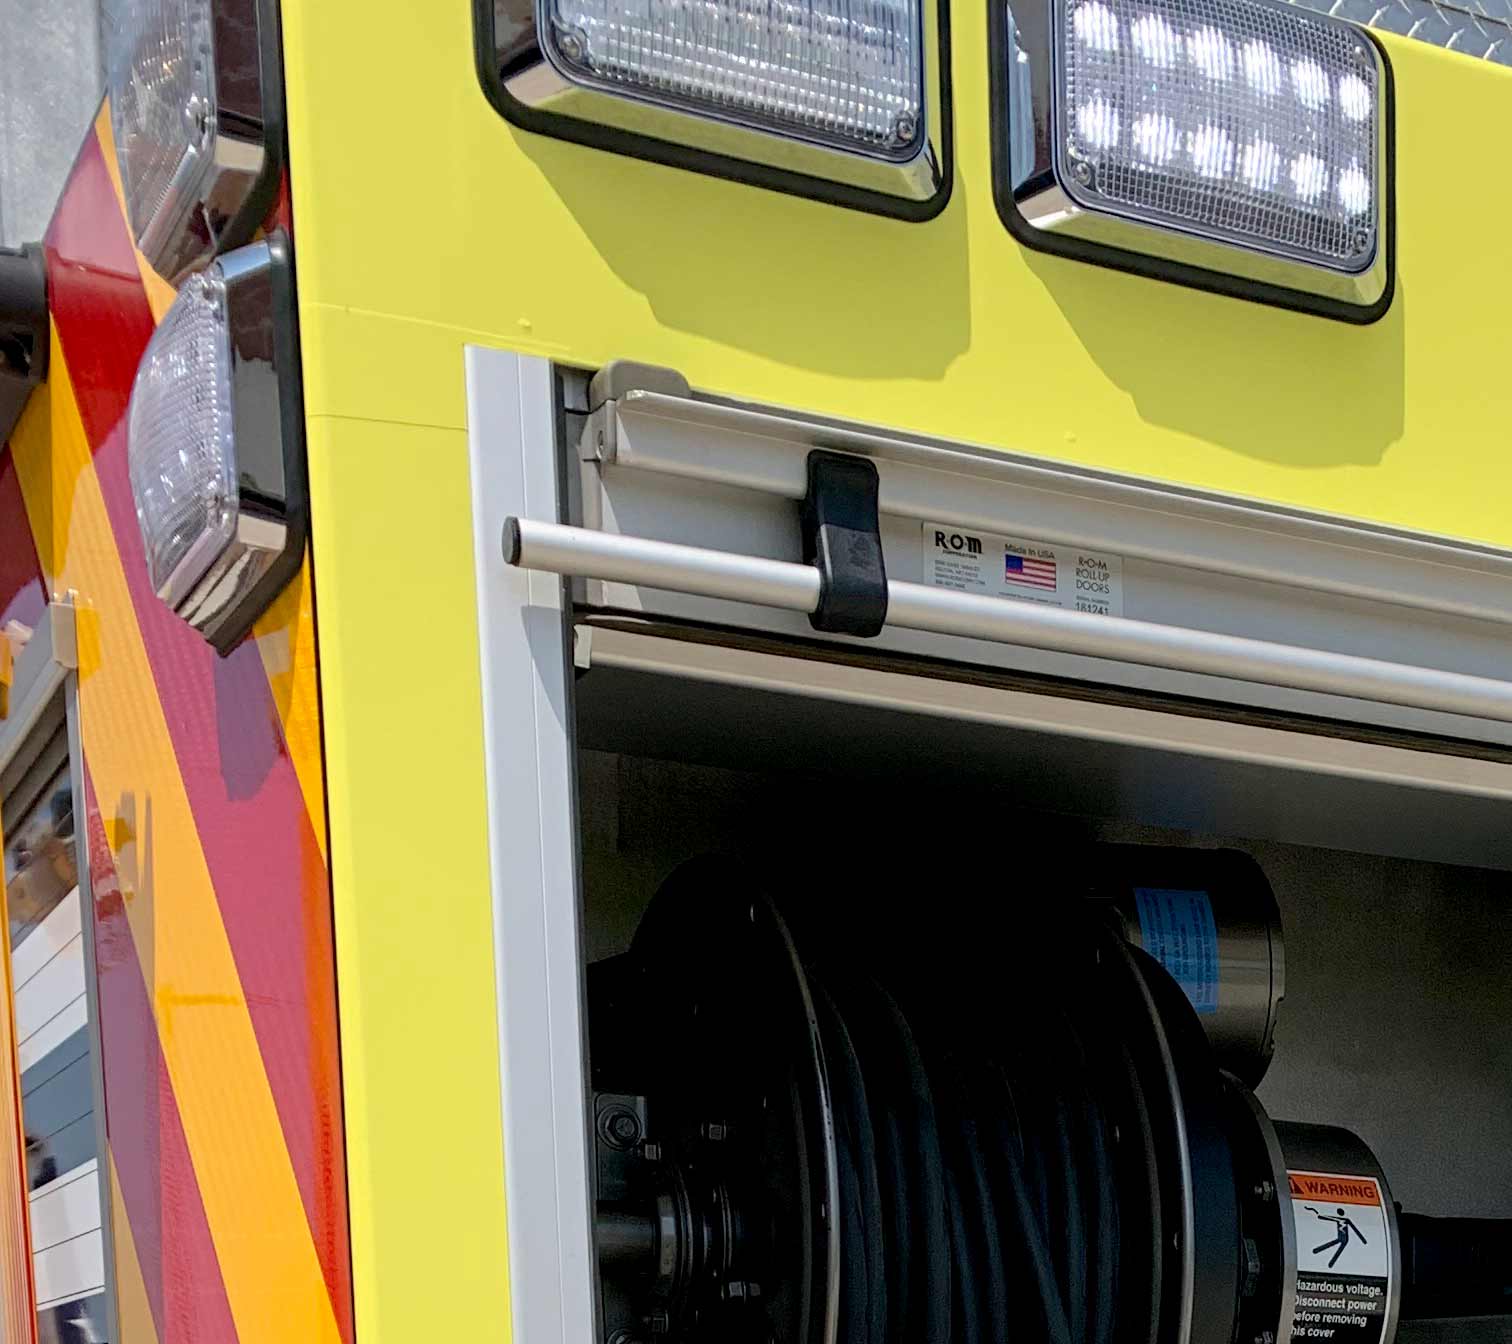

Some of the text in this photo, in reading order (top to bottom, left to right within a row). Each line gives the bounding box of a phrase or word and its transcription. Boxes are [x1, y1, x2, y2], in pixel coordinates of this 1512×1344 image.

[1076, 579, 1110, 594] DOORS
[1305, 1180, 1375, 1199] WARNING
[1346, 1284, 1384, 1298] voltage.
[1347, 1300, 1377, 1313] power
[1322, 1313, 1367, 1328] removing
[1291, 1322, 1335, 1339] his cover
